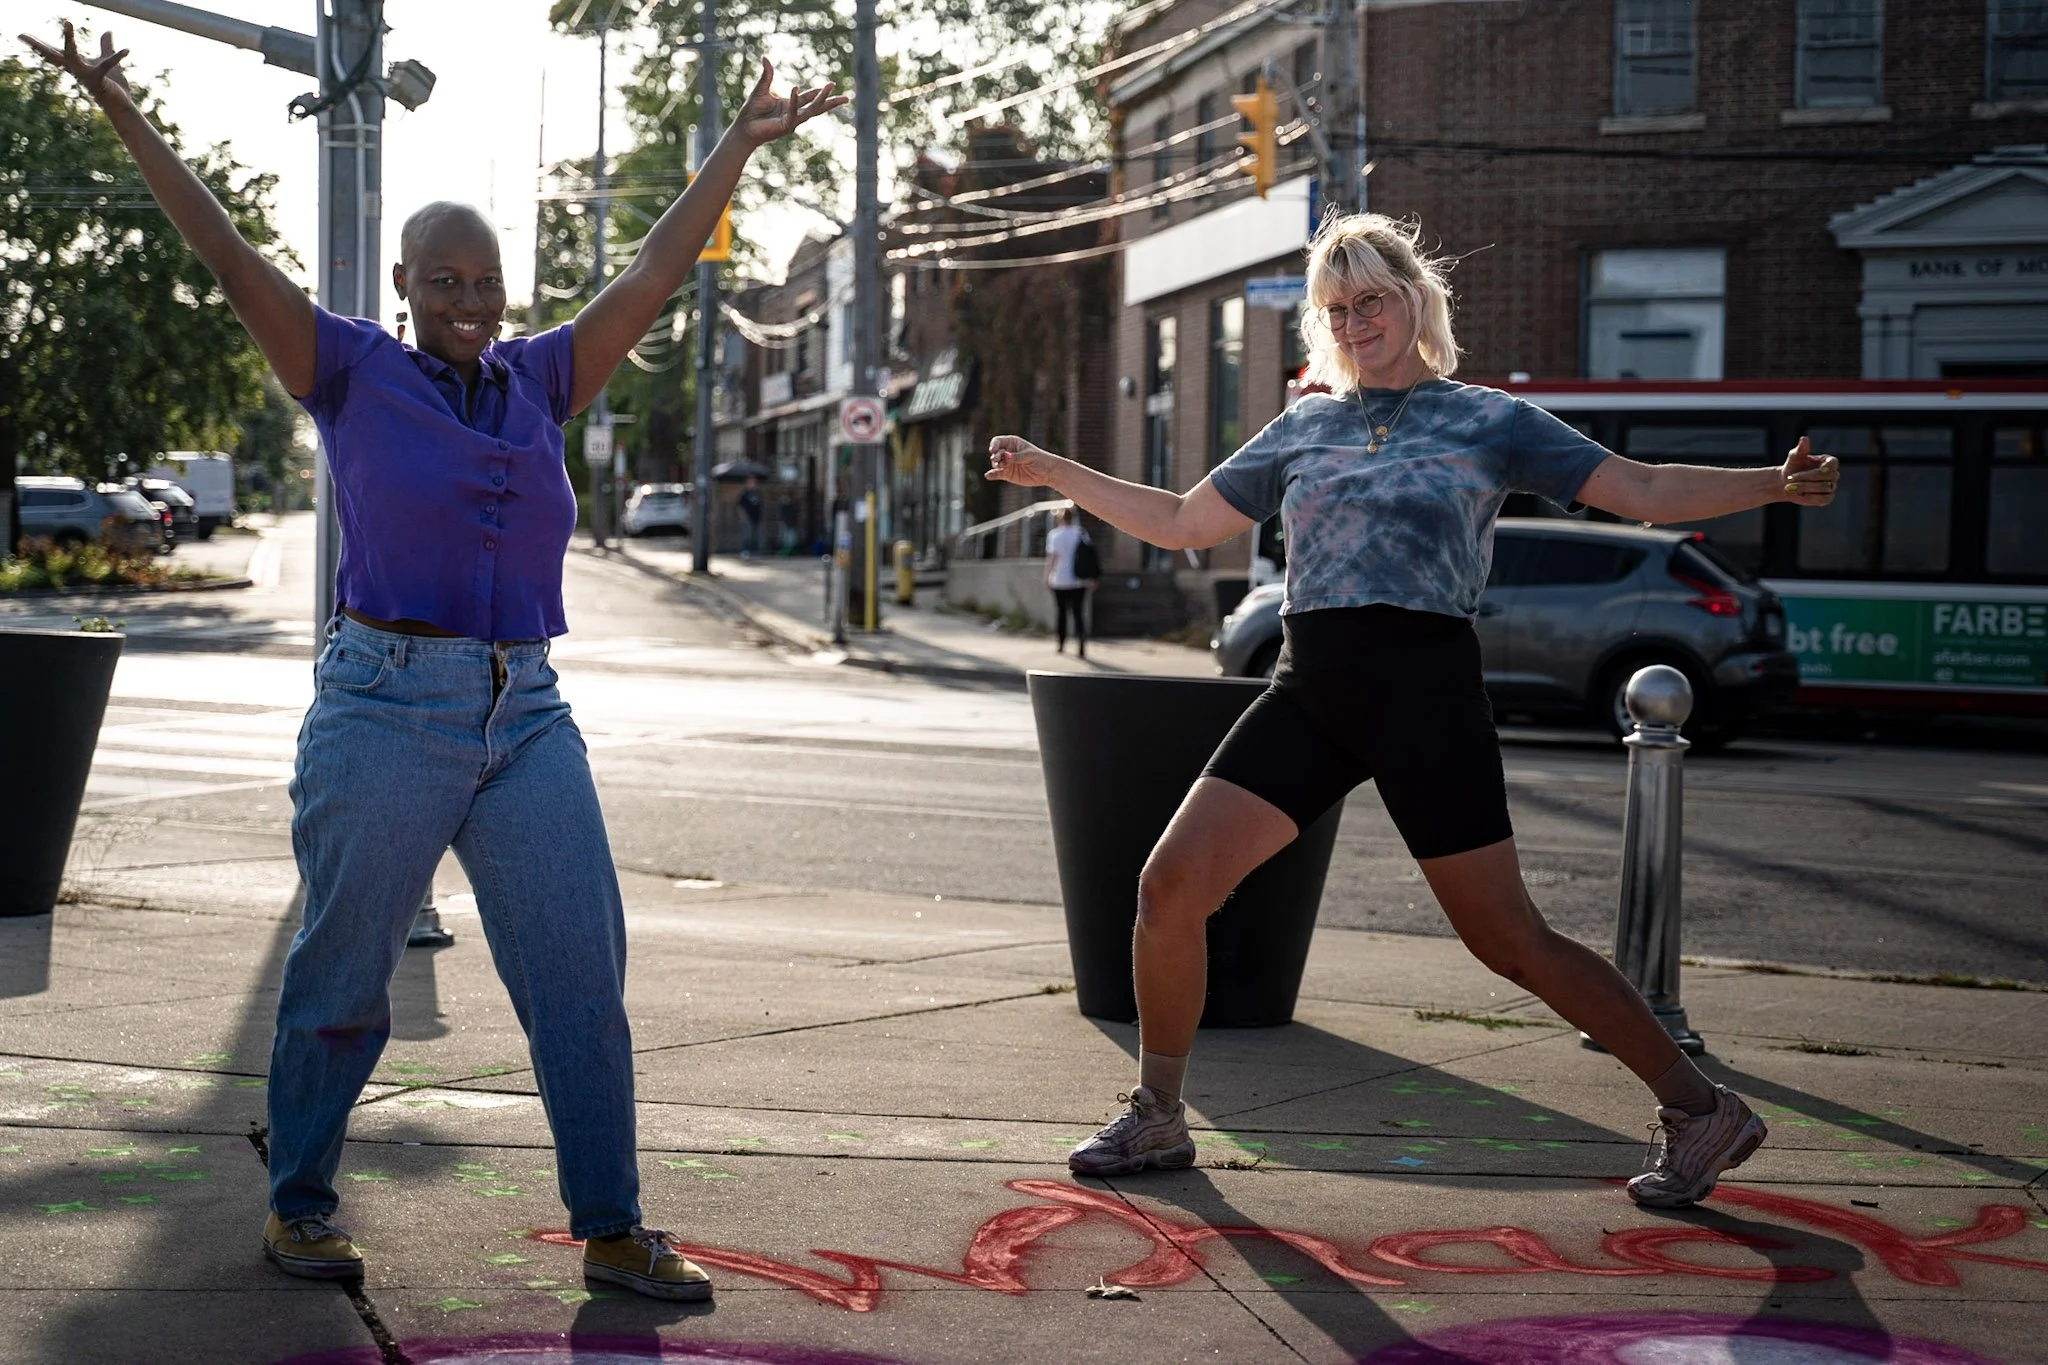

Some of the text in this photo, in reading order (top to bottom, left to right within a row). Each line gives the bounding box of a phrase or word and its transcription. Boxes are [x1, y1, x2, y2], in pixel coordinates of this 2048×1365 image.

[1910, 261, 1967, 278] BANK
[1976, 258, 2005, 276] OF
[1934, 604, 2048, 637] FARBE
